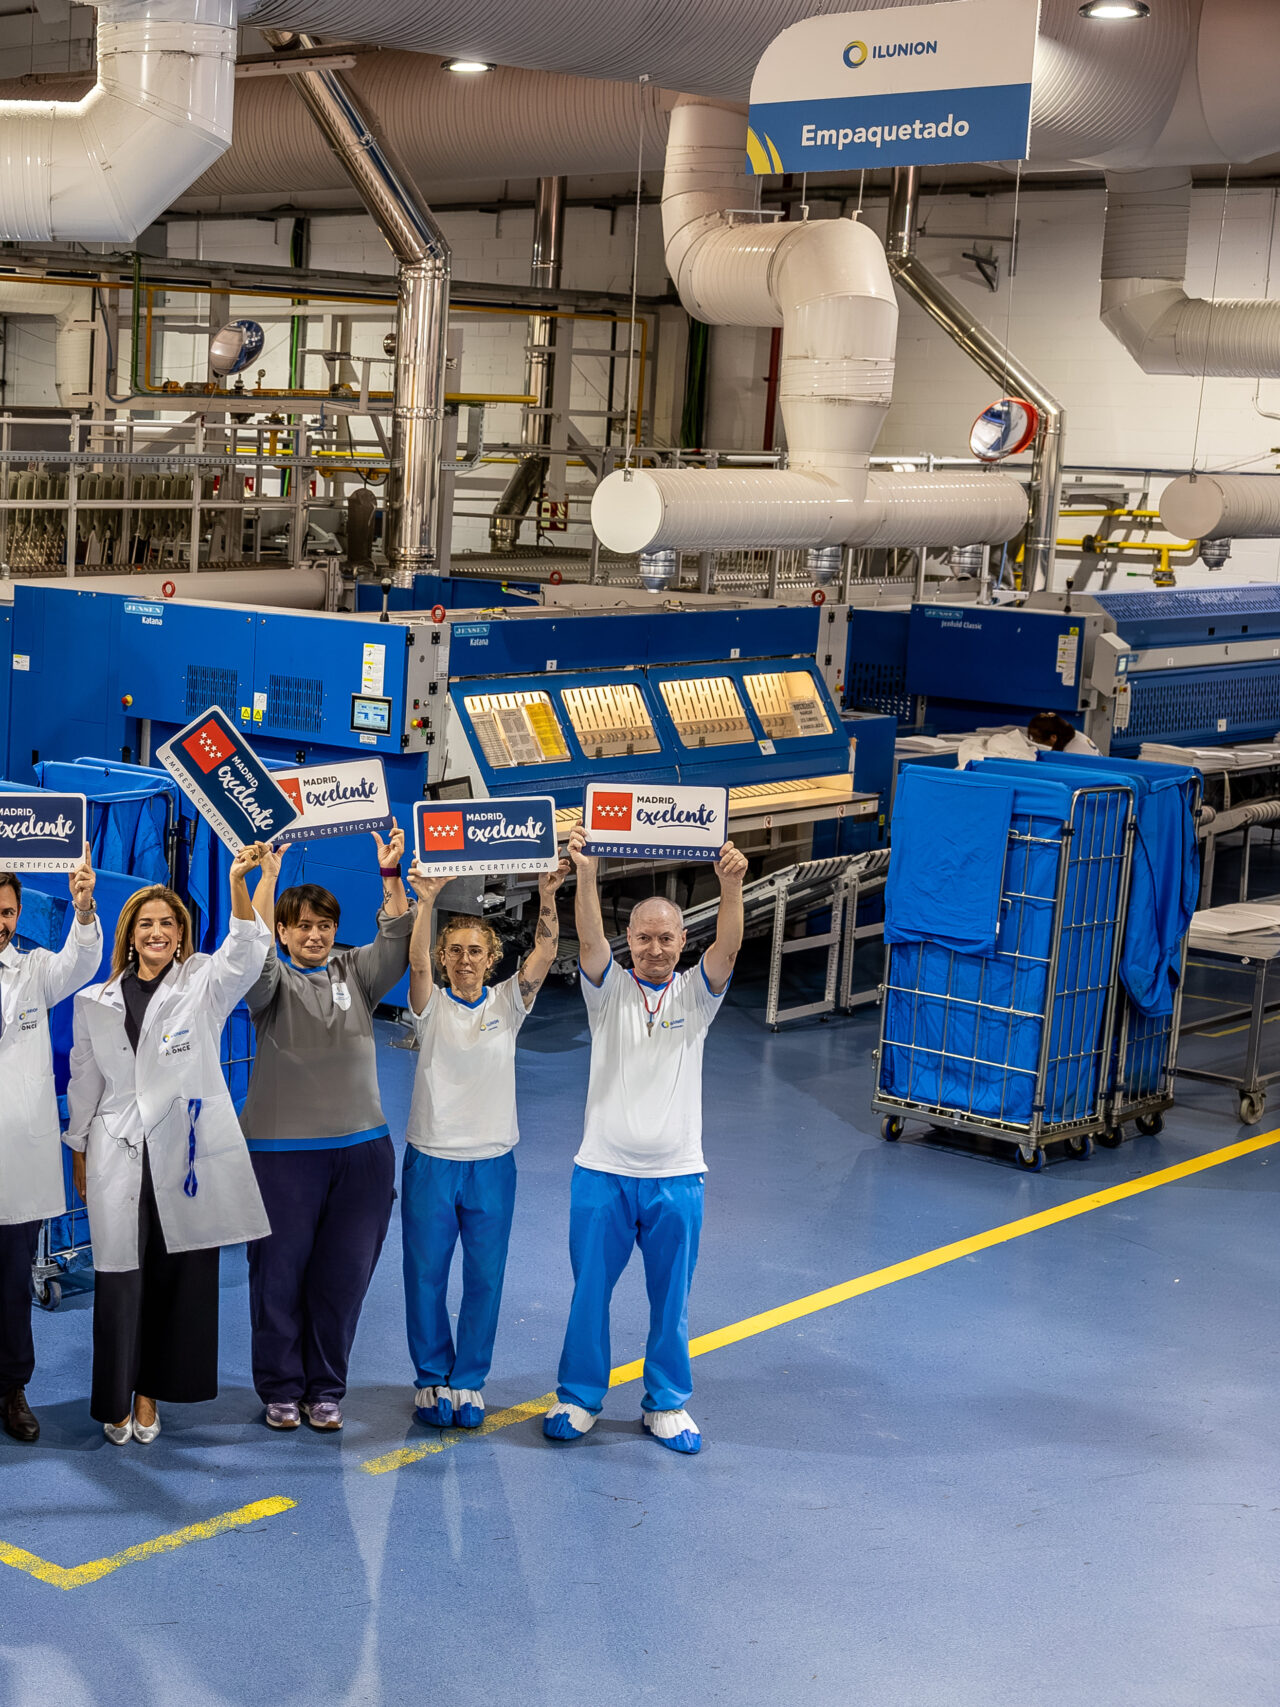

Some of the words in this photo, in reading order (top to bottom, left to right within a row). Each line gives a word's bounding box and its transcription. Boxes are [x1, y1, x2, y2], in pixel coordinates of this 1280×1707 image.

[872, 40, 938, 59] ILUNION
[801, 113, 969, 150] Empaquetado
[126, 604, 161, 613] JENSEN
[142, 616, 163, 625] Katana
[455, 626, 488, 635] JENSEN
[470, 638, 489, 646] Katana
[164, 755, 196, 795] EMPRESA
[231, 755, 259, 788] MADRID
[303, 775, 338, 787] MADRID
[218, 765, 274, 831] excelente
[305, 777, 378, 807] excelente
[636, 796, 675, 804] MADRID
[466, 812, 503, 821] MADRID
[636, 803, 717, 826] excelente
[277, 830, 315, 841] MPRESA
[320, 821, 385, 835] CERTIFICADA
[467, 816, 546, 842] excelente
[590, 845, 638, 854] EMPRESA
[644, 848, 716, 857] CERTIFICADA
[5, 861, 76, 869] CERTIFICADA
[427, 865, 474, 873] EMPRESA
[479, 862, 549, 871] CERTIFICADA
[172, 1045, 190, 1054] ONCE
